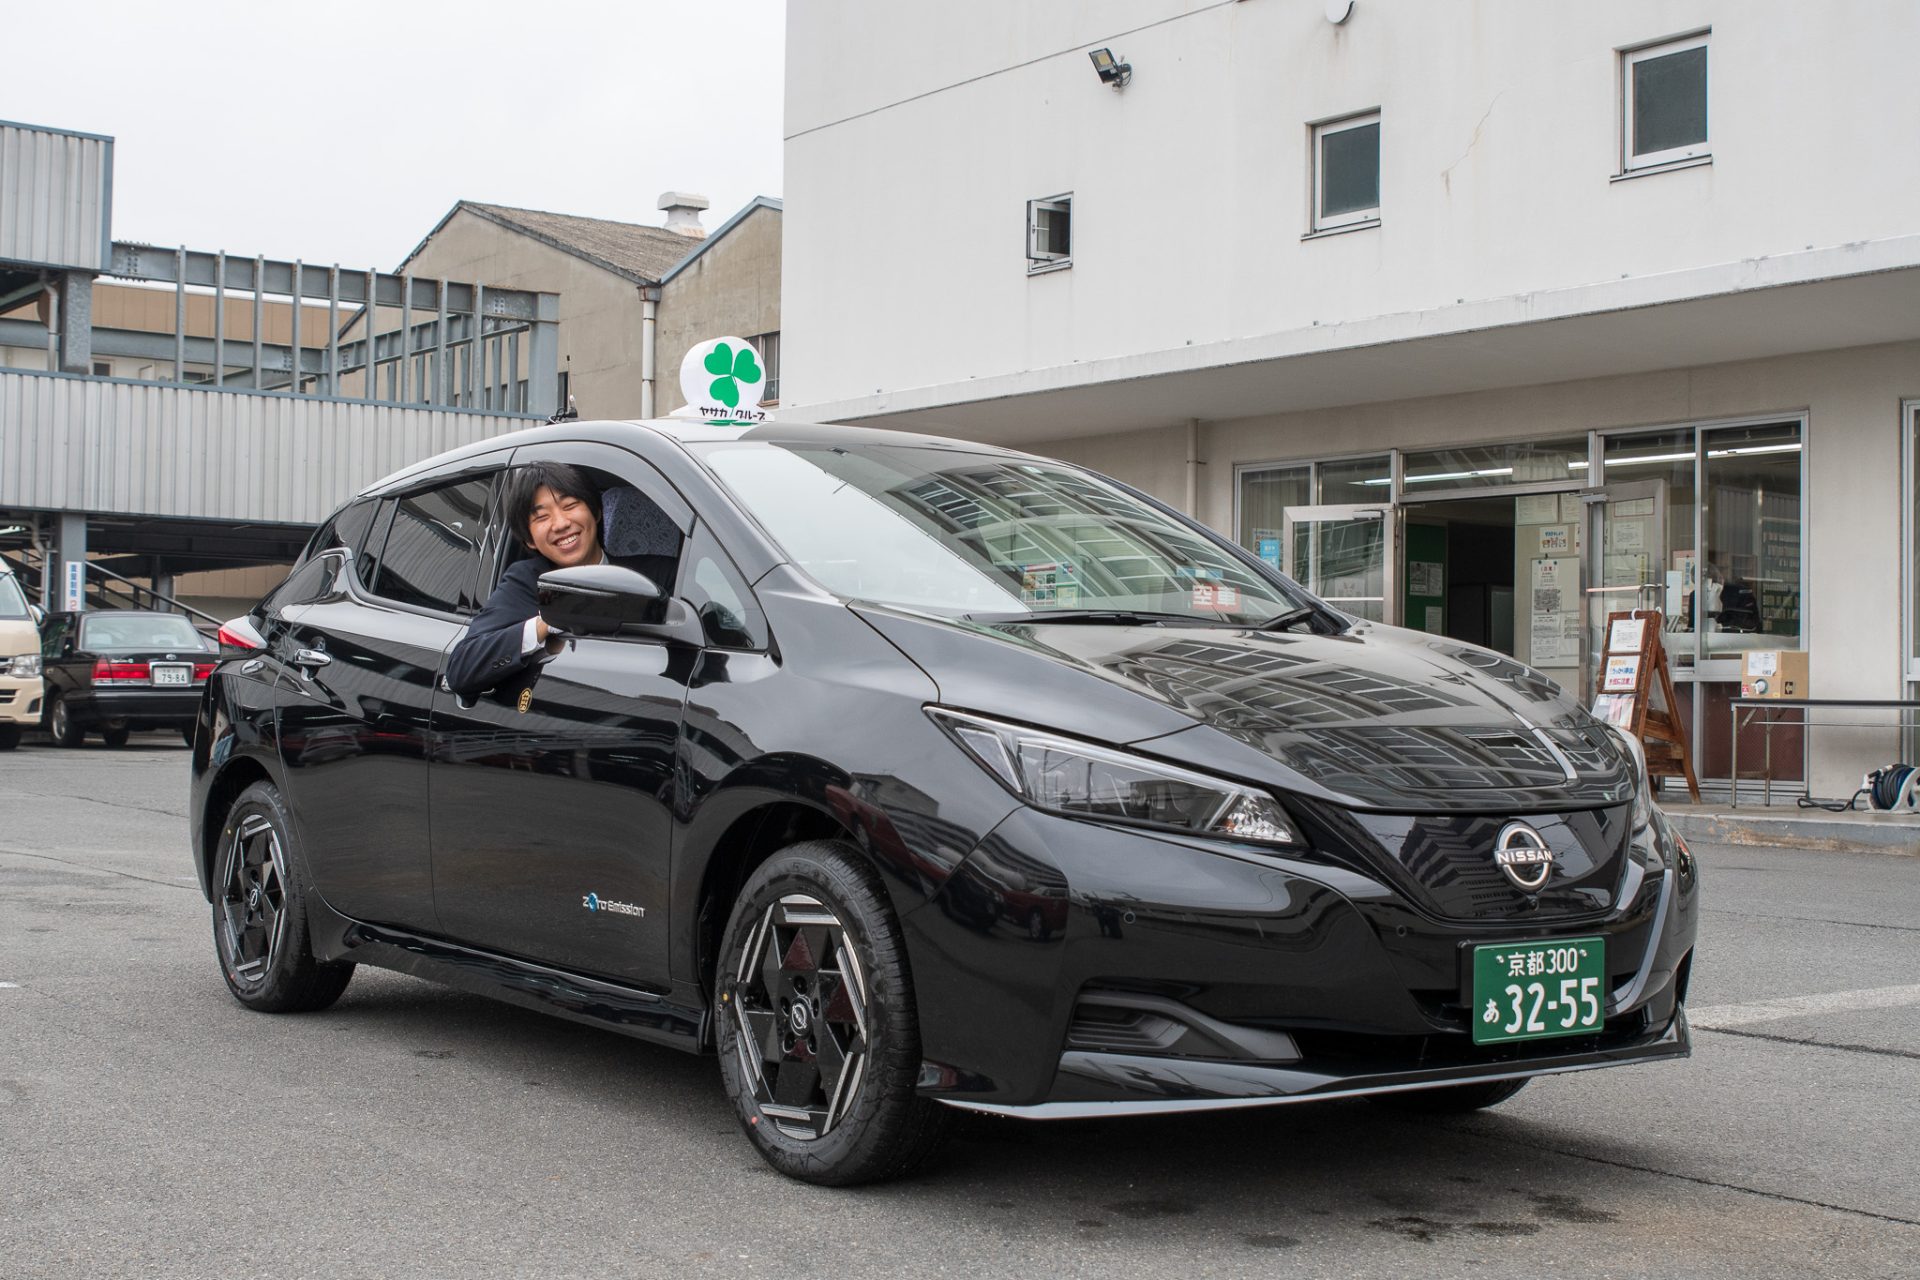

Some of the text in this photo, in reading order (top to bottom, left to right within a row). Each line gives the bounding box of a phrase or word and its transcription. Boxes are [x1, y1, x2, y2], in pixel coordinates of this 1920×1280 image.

[699, 406, 728, 418] ヤサカ
[1497, 850, 1553, 864] NISSAN
[608, 900, 646, 918] Emission
[1507, 947, 1578, 977] 京都300
[1483, 977, 1599, 1034] あ 32-55
